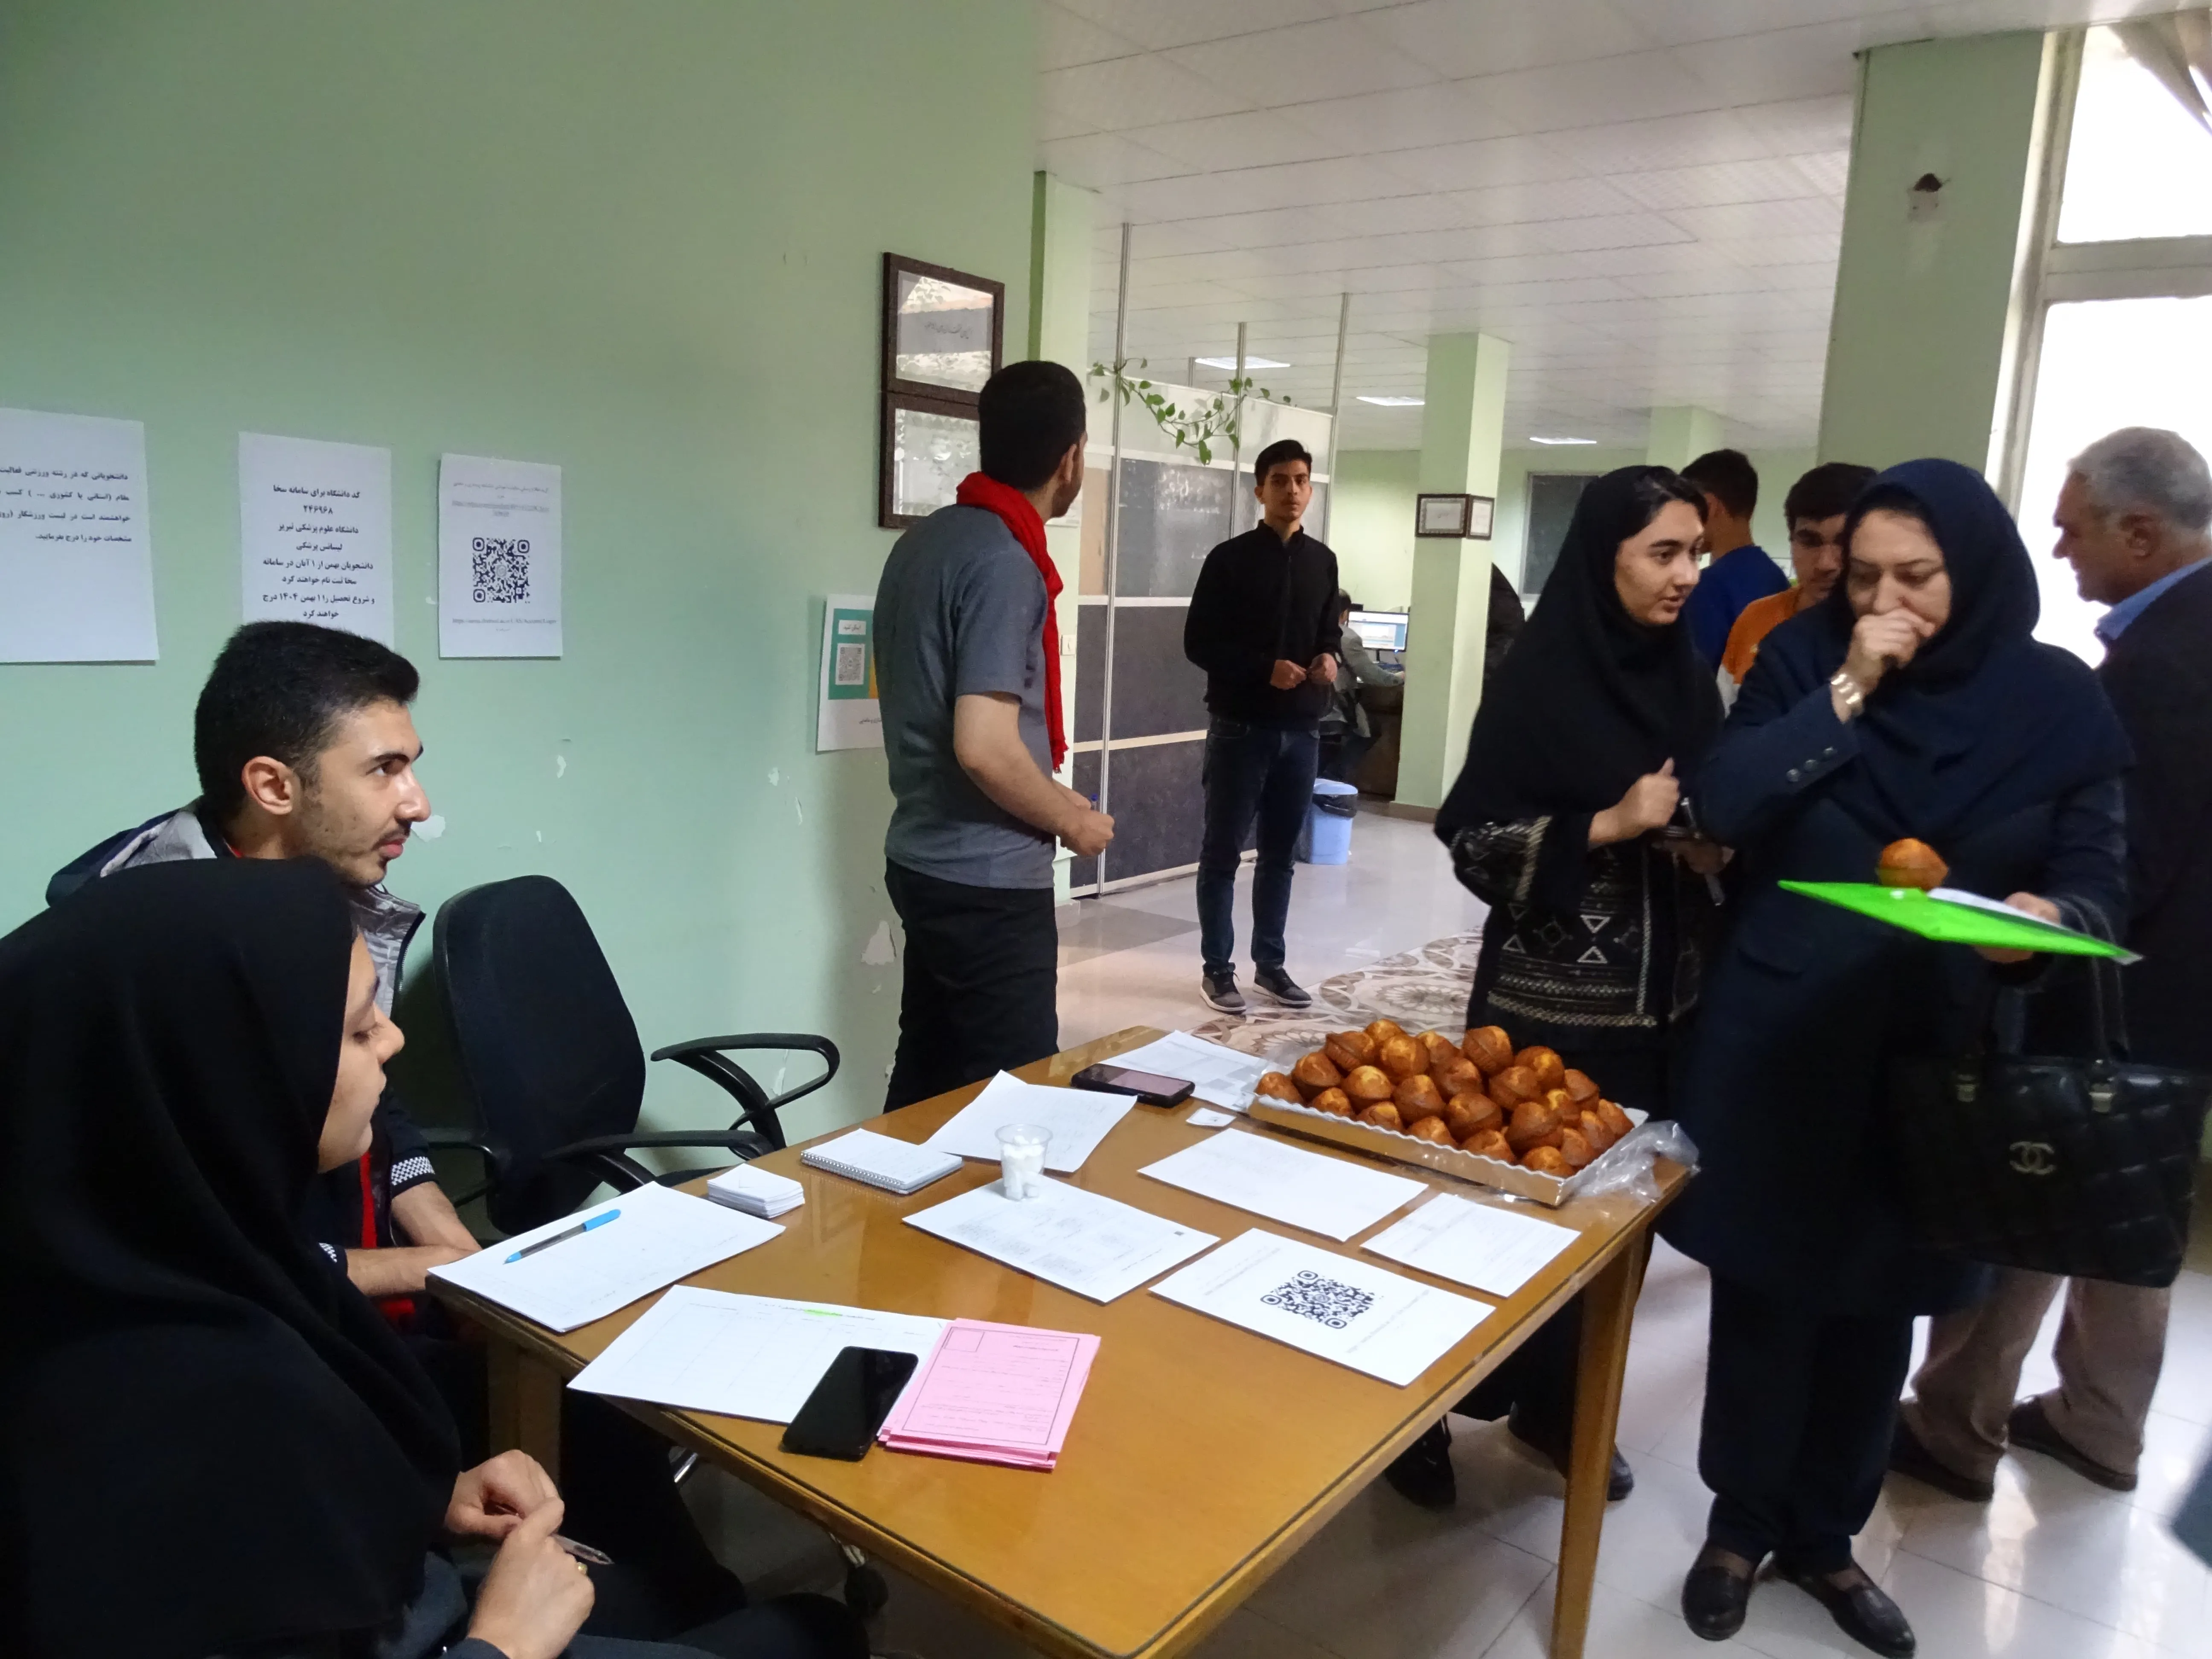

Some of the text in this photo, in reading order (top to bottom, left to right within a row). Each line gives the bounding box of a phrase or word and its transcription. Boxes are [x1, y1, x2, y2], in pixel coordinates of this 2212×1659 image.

[52, 470, 67, 478] رشته
[70, 471, 78, 480] در
[91, 472, 128, 481] دانشجویانی
[49, 492, 73, 500] کشوری
[310, 488, 326, 498] برای
[326, 489, 350, 498] دانشگاه
[17, 510, 45, 520] ورزشکار
[99, 515, 131, 523] خواهشمند
[278, 523, 359, 535] دانشگاه علوم پزشکی تبریز
[80, 534, 87, 543] را
[296, 541, 343, 552] لیسانس پزشکی
[285, 560, 294, 568] در
[295, 559, 310, 569] آبان
[317, 560, 323, 570] از
[341, 562, 373, 571] دانشجویان
[282, 575, 295, 585] کرد
[297, 576, 320, 585] خواهند
[321, 576, 331, 585] نام
[262, 594, 278, 602] درج
[279, 592, 298, 600] ۱۴۰۴
[322, 594, 329, 603] را
[330, 595, 351, 603] تحصیل
[352, 596, 370, 604] شروع
[303, 609, 339, 620] خواهند کرد
